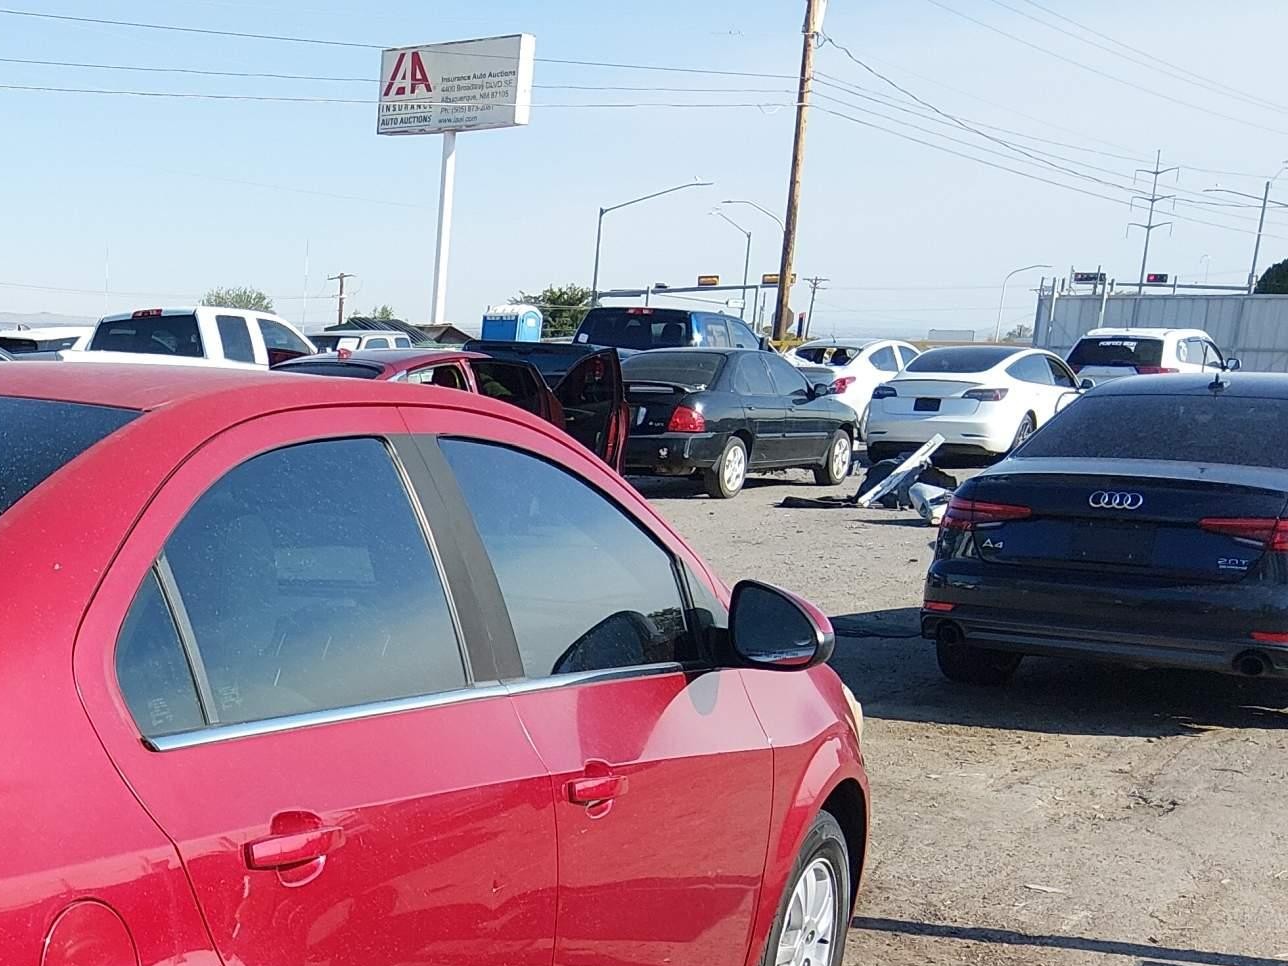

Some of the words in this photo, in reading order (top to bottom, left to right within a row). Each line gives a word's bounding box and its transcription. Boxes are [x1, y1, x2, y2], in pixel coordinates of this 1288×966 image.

[472, 72, 486, 80] Auto
[488, 70, 516, 78] Auctions
[382, 102, 433, 112] INSURANCE
[381, 118, 398, 126] AUTO
[399, 114, 432, 125] AUCTIONS
[982, 538, 1004, 549] A4
